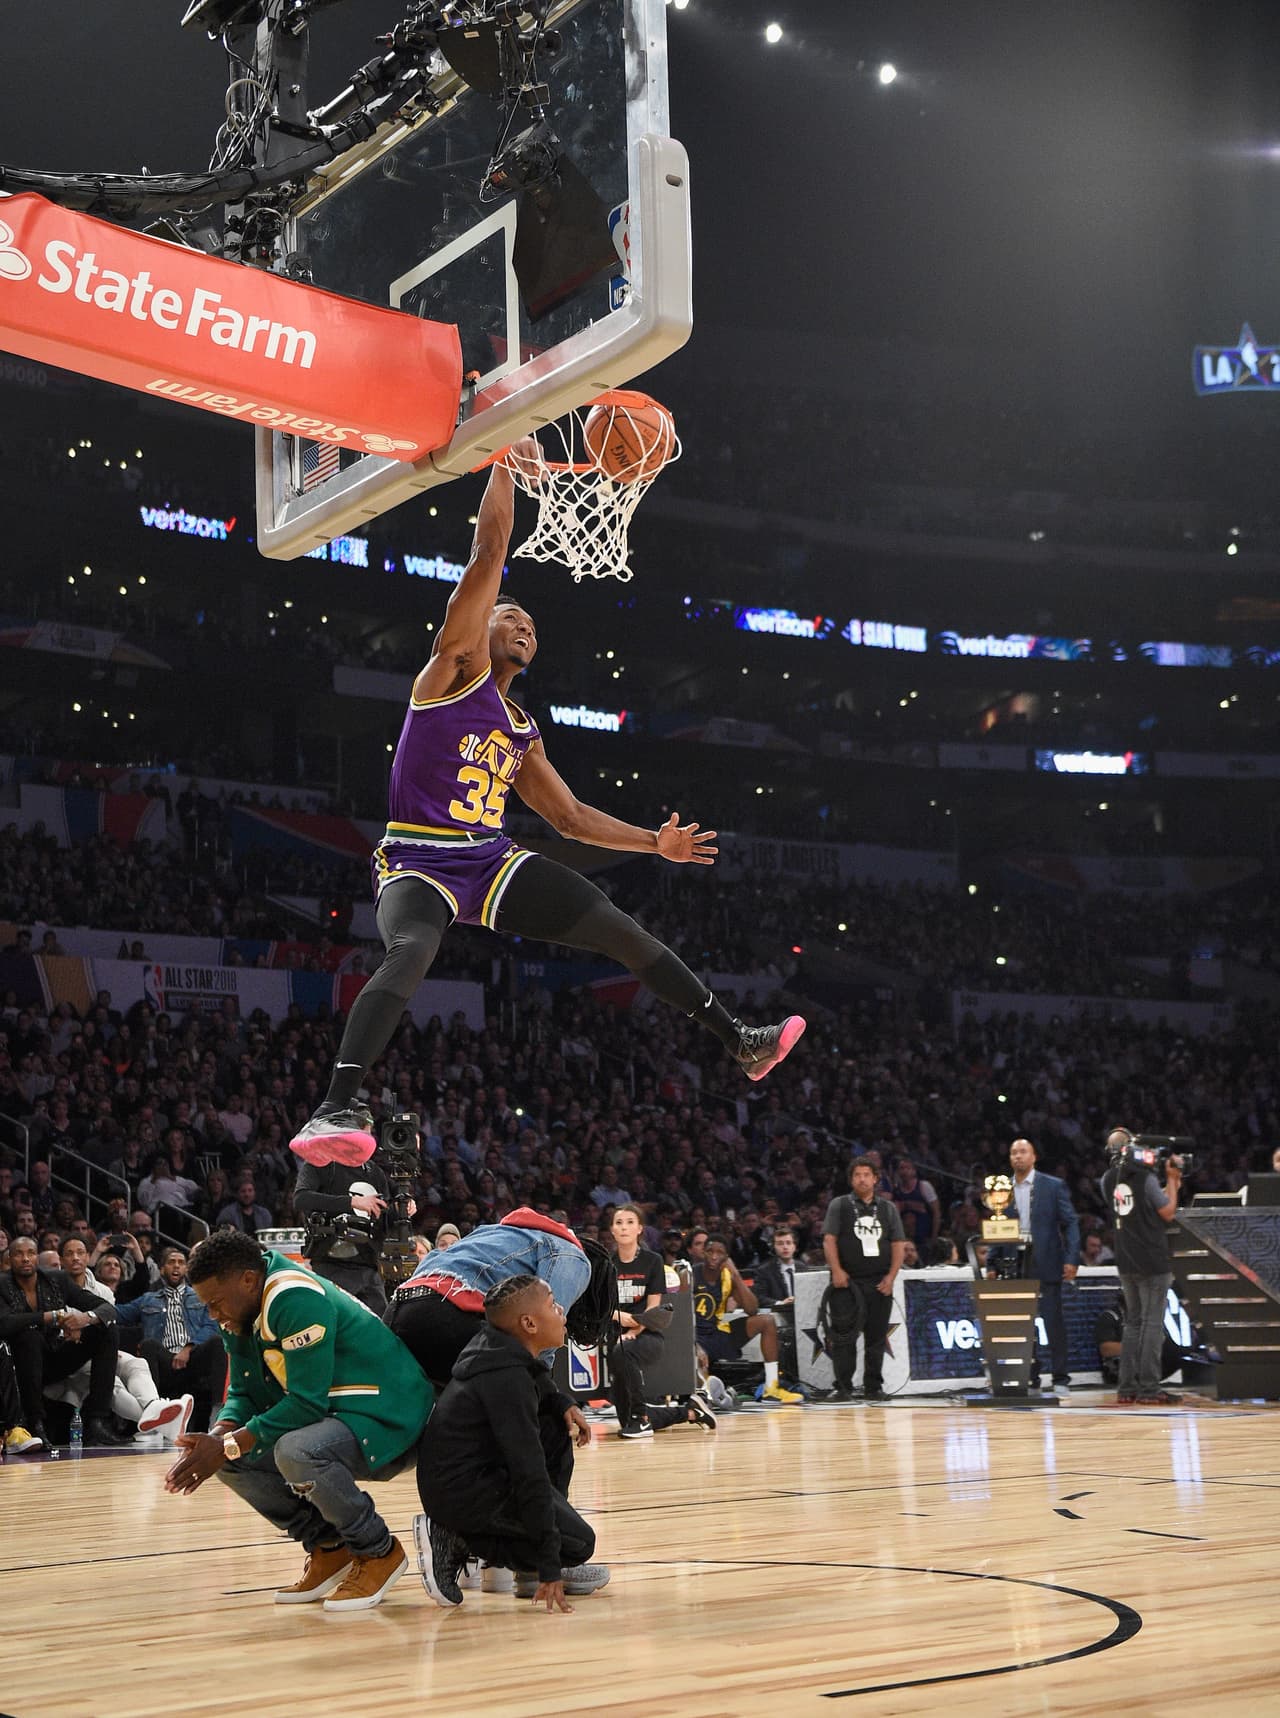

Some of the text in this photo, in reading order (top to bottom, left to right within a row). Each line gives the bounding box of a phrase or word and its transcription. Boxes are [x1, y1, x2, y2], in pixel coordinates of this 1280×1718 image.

[1203, 353, 1233, 386] LA
[140, 506, 227, 540] verizon
[403, 554, 466, 583] verizo
[745, 612, 815, 638] verizon
[956, 635, 1029, 658] verizon
[550, 705, 620, 732] verizon
[449, 765, 510, 829] 35
[165, 967, 183, 989] ALL
[185, 968, 213, 990] STAR
[696, 1298, 707, 1317] 4
[290, 1333, 311, 1349] TOM
